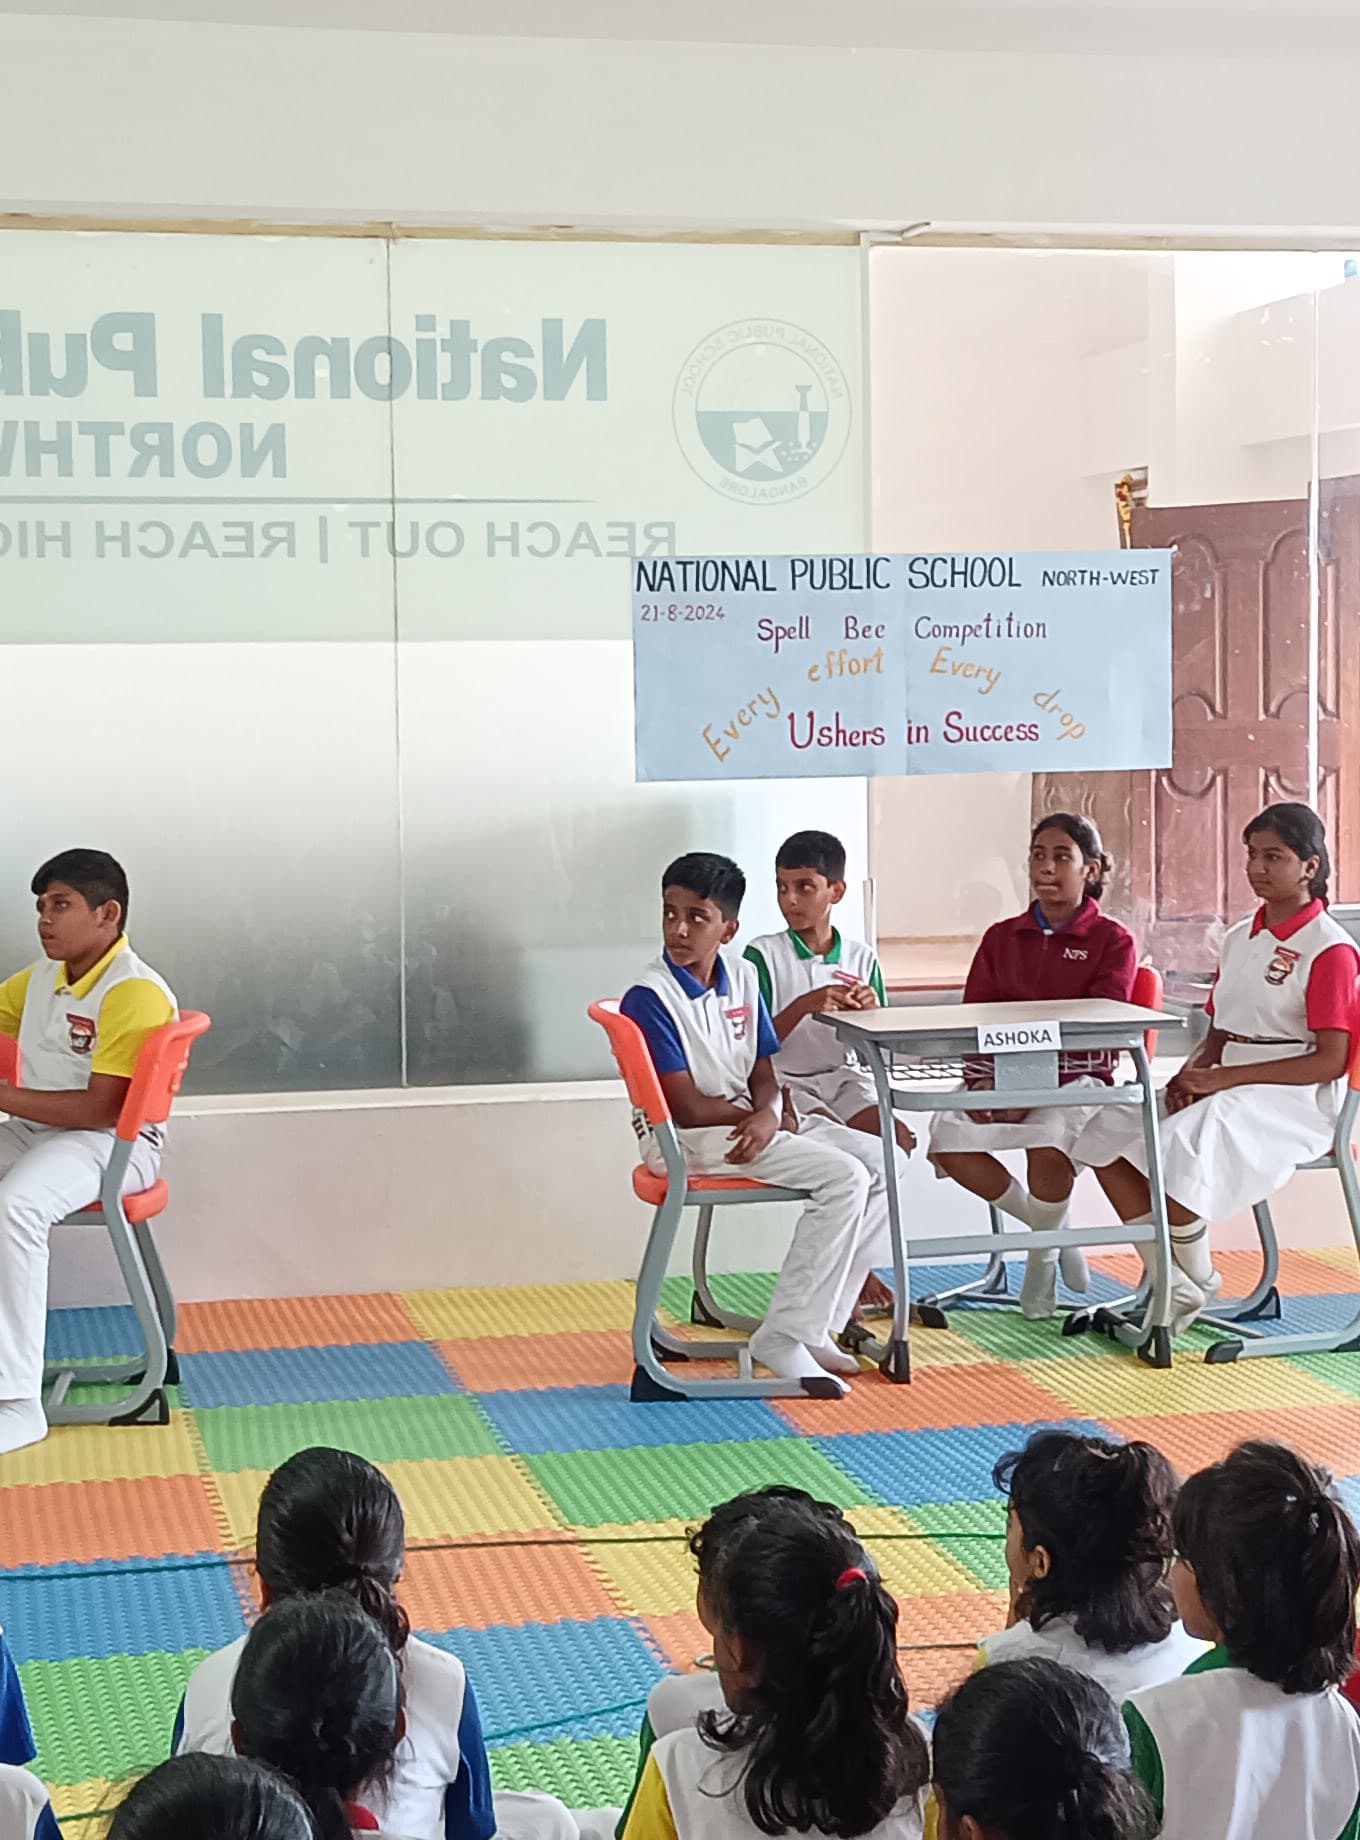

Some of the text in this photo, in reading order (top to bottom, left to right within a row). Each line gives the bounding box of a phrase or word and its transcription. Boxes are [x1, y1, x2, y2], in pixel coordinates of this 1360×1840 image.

[635, 556, 1160, 593] NATIONAL PUBLIC SCHOOL NORTH-WEST
[640, 604, 725, 621] 21-8-2024
[757, 611, 1048, 654] Spell Bee Competition
[702, 645, 1086, 762] Every effort Every drop
[787, 710, 1040, 749] Ushers in Success
[984, 1029, 1052, 1046] ASHOKA
